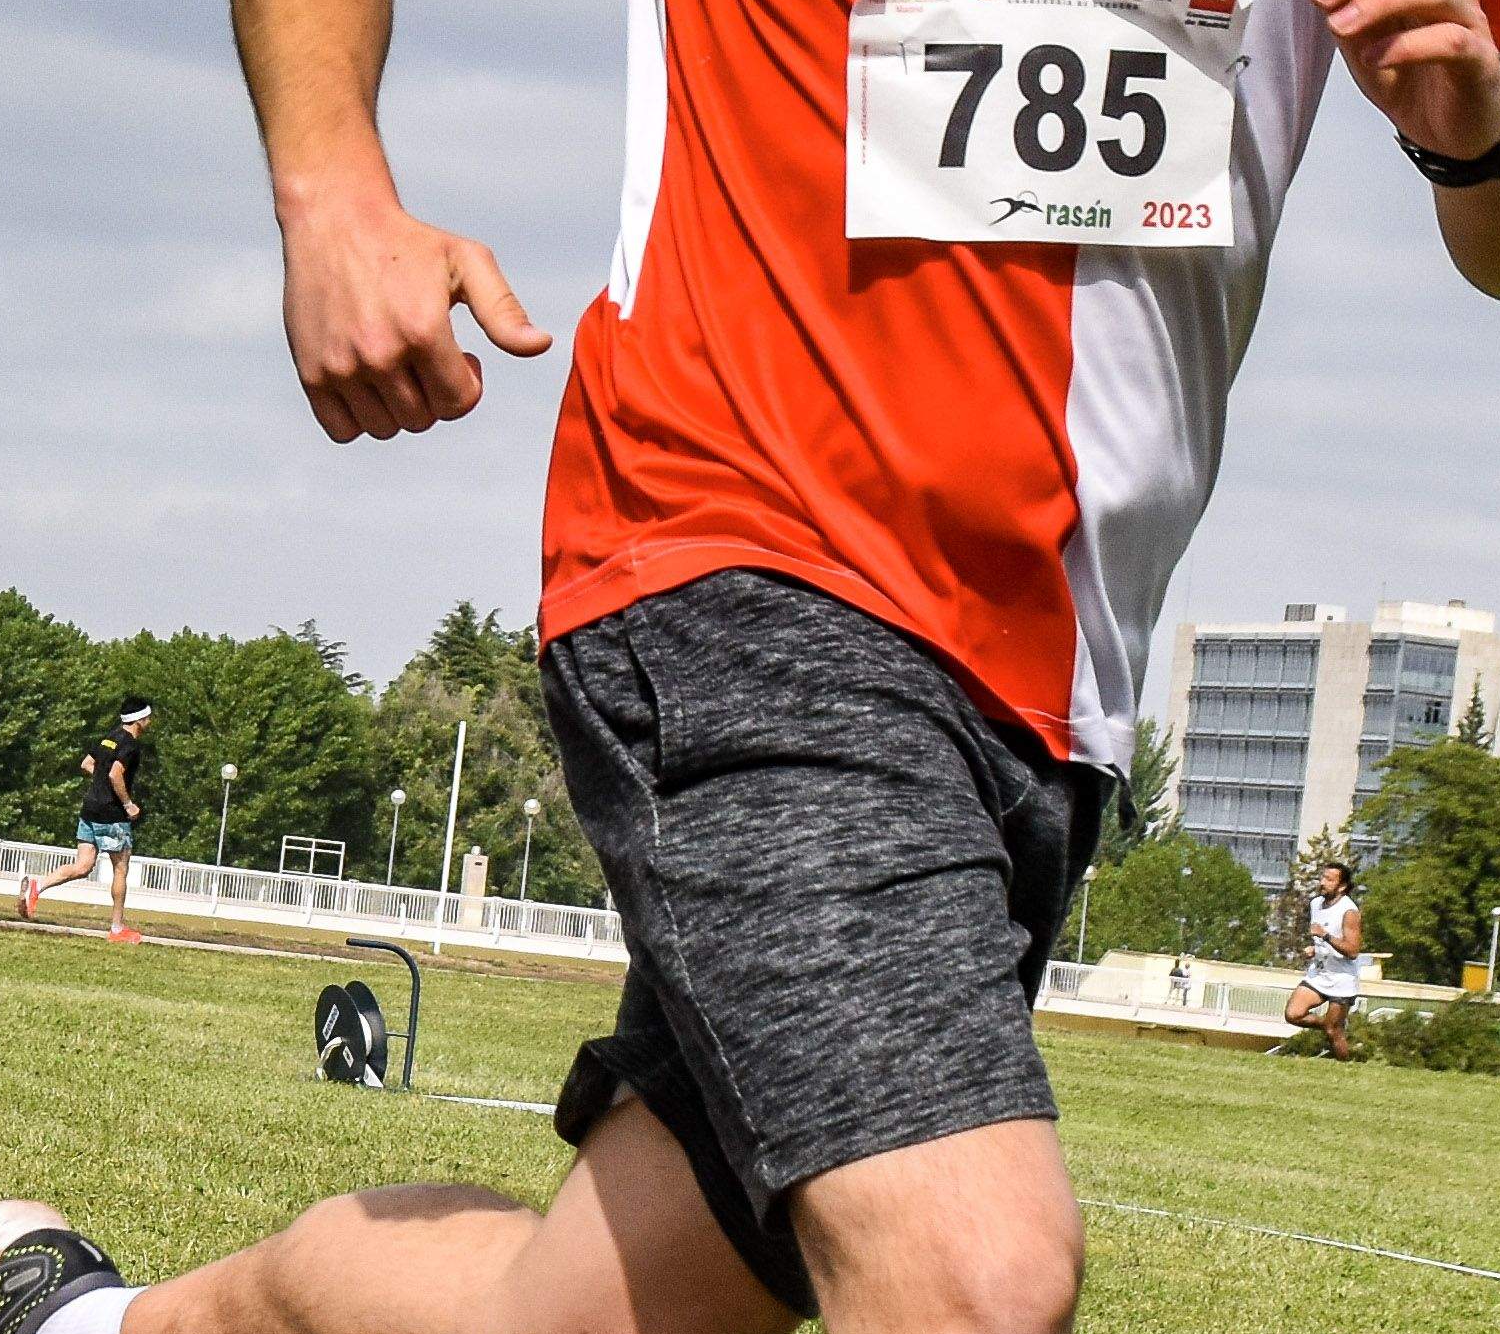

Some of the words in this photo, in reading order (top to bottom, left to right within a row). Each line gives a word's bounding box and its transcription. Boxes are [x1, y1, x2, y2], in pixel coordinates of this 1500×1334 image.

[923, 43, 1168, 178] 785
[1045, 200, 1112, 229] rasán
[1142, 202, 1213, 229] 2023
